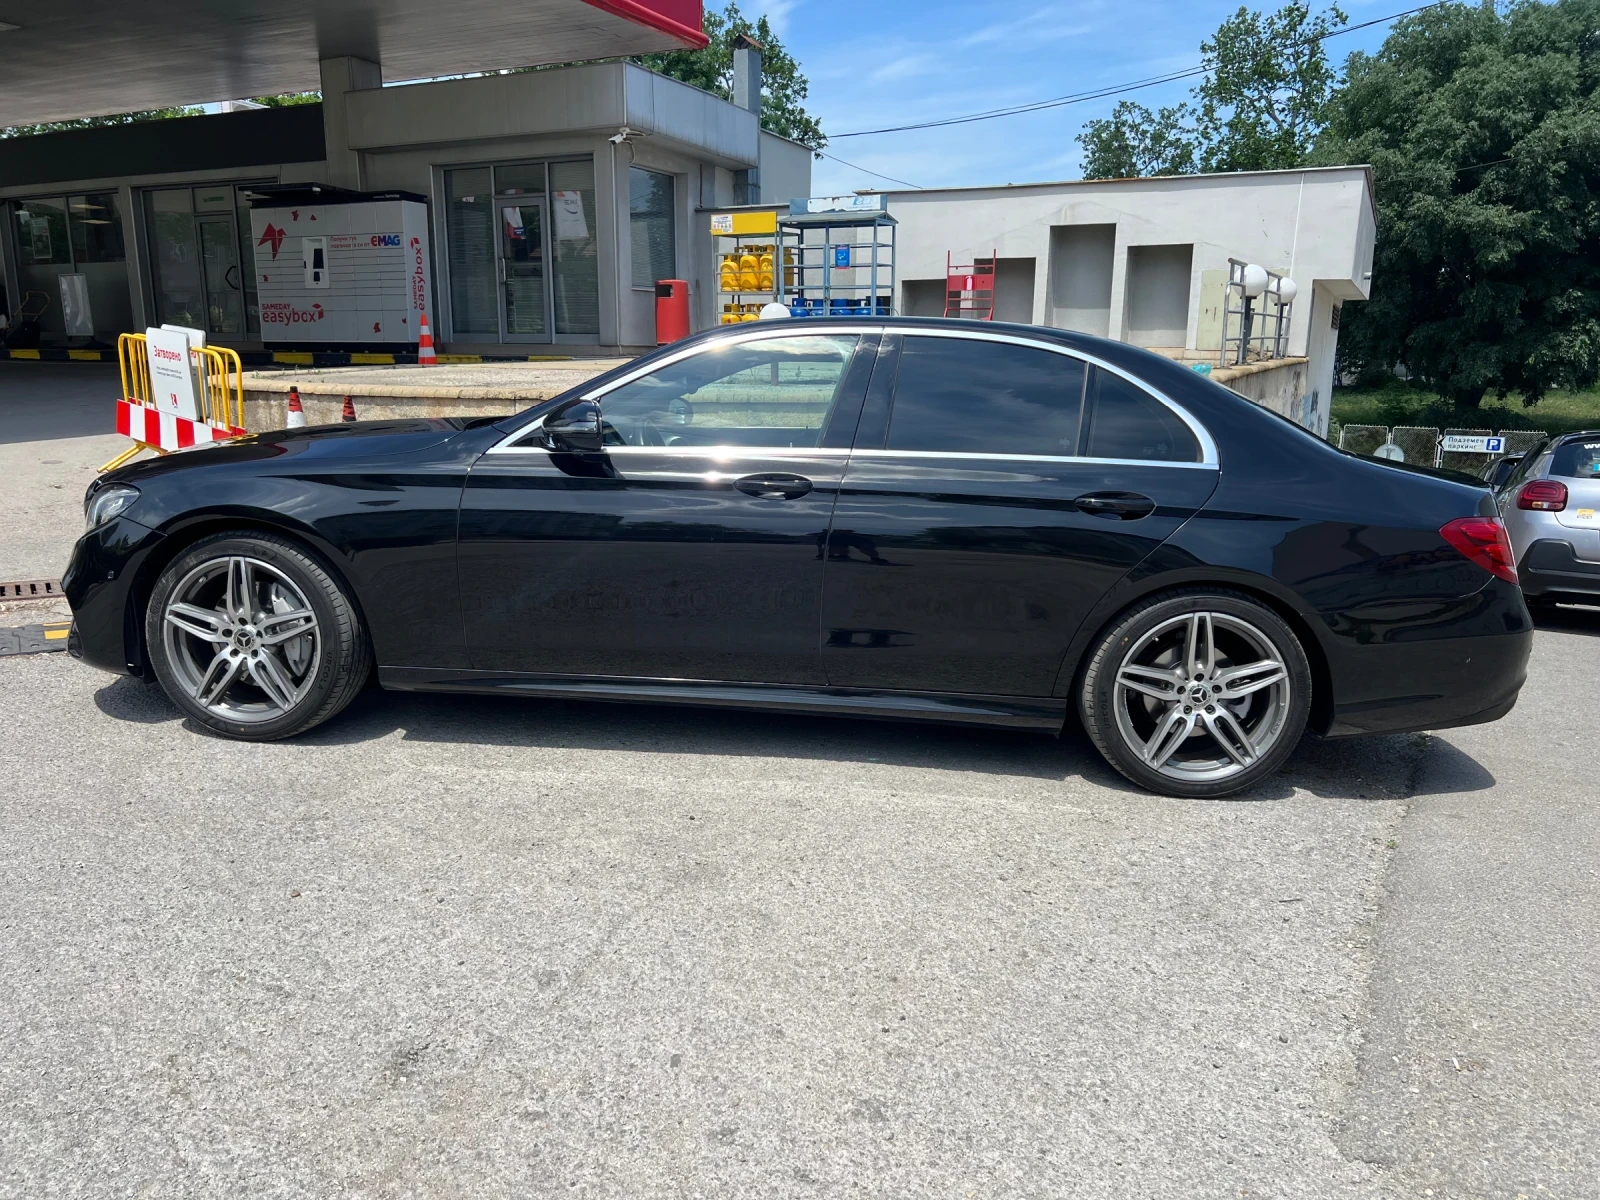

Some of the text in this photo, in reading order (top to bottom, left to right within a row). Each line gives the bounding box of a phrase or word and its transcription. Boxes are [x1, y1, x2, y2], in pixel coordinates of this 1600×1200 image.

[414, 247, 426, 311] easybox
[262, 308, 317, 326] easybox
[153, 345, 182, 362] Затворено
[1448, 436, 1484, 444] Подземен
[1101, 691, 1112, 729] URCOLA
